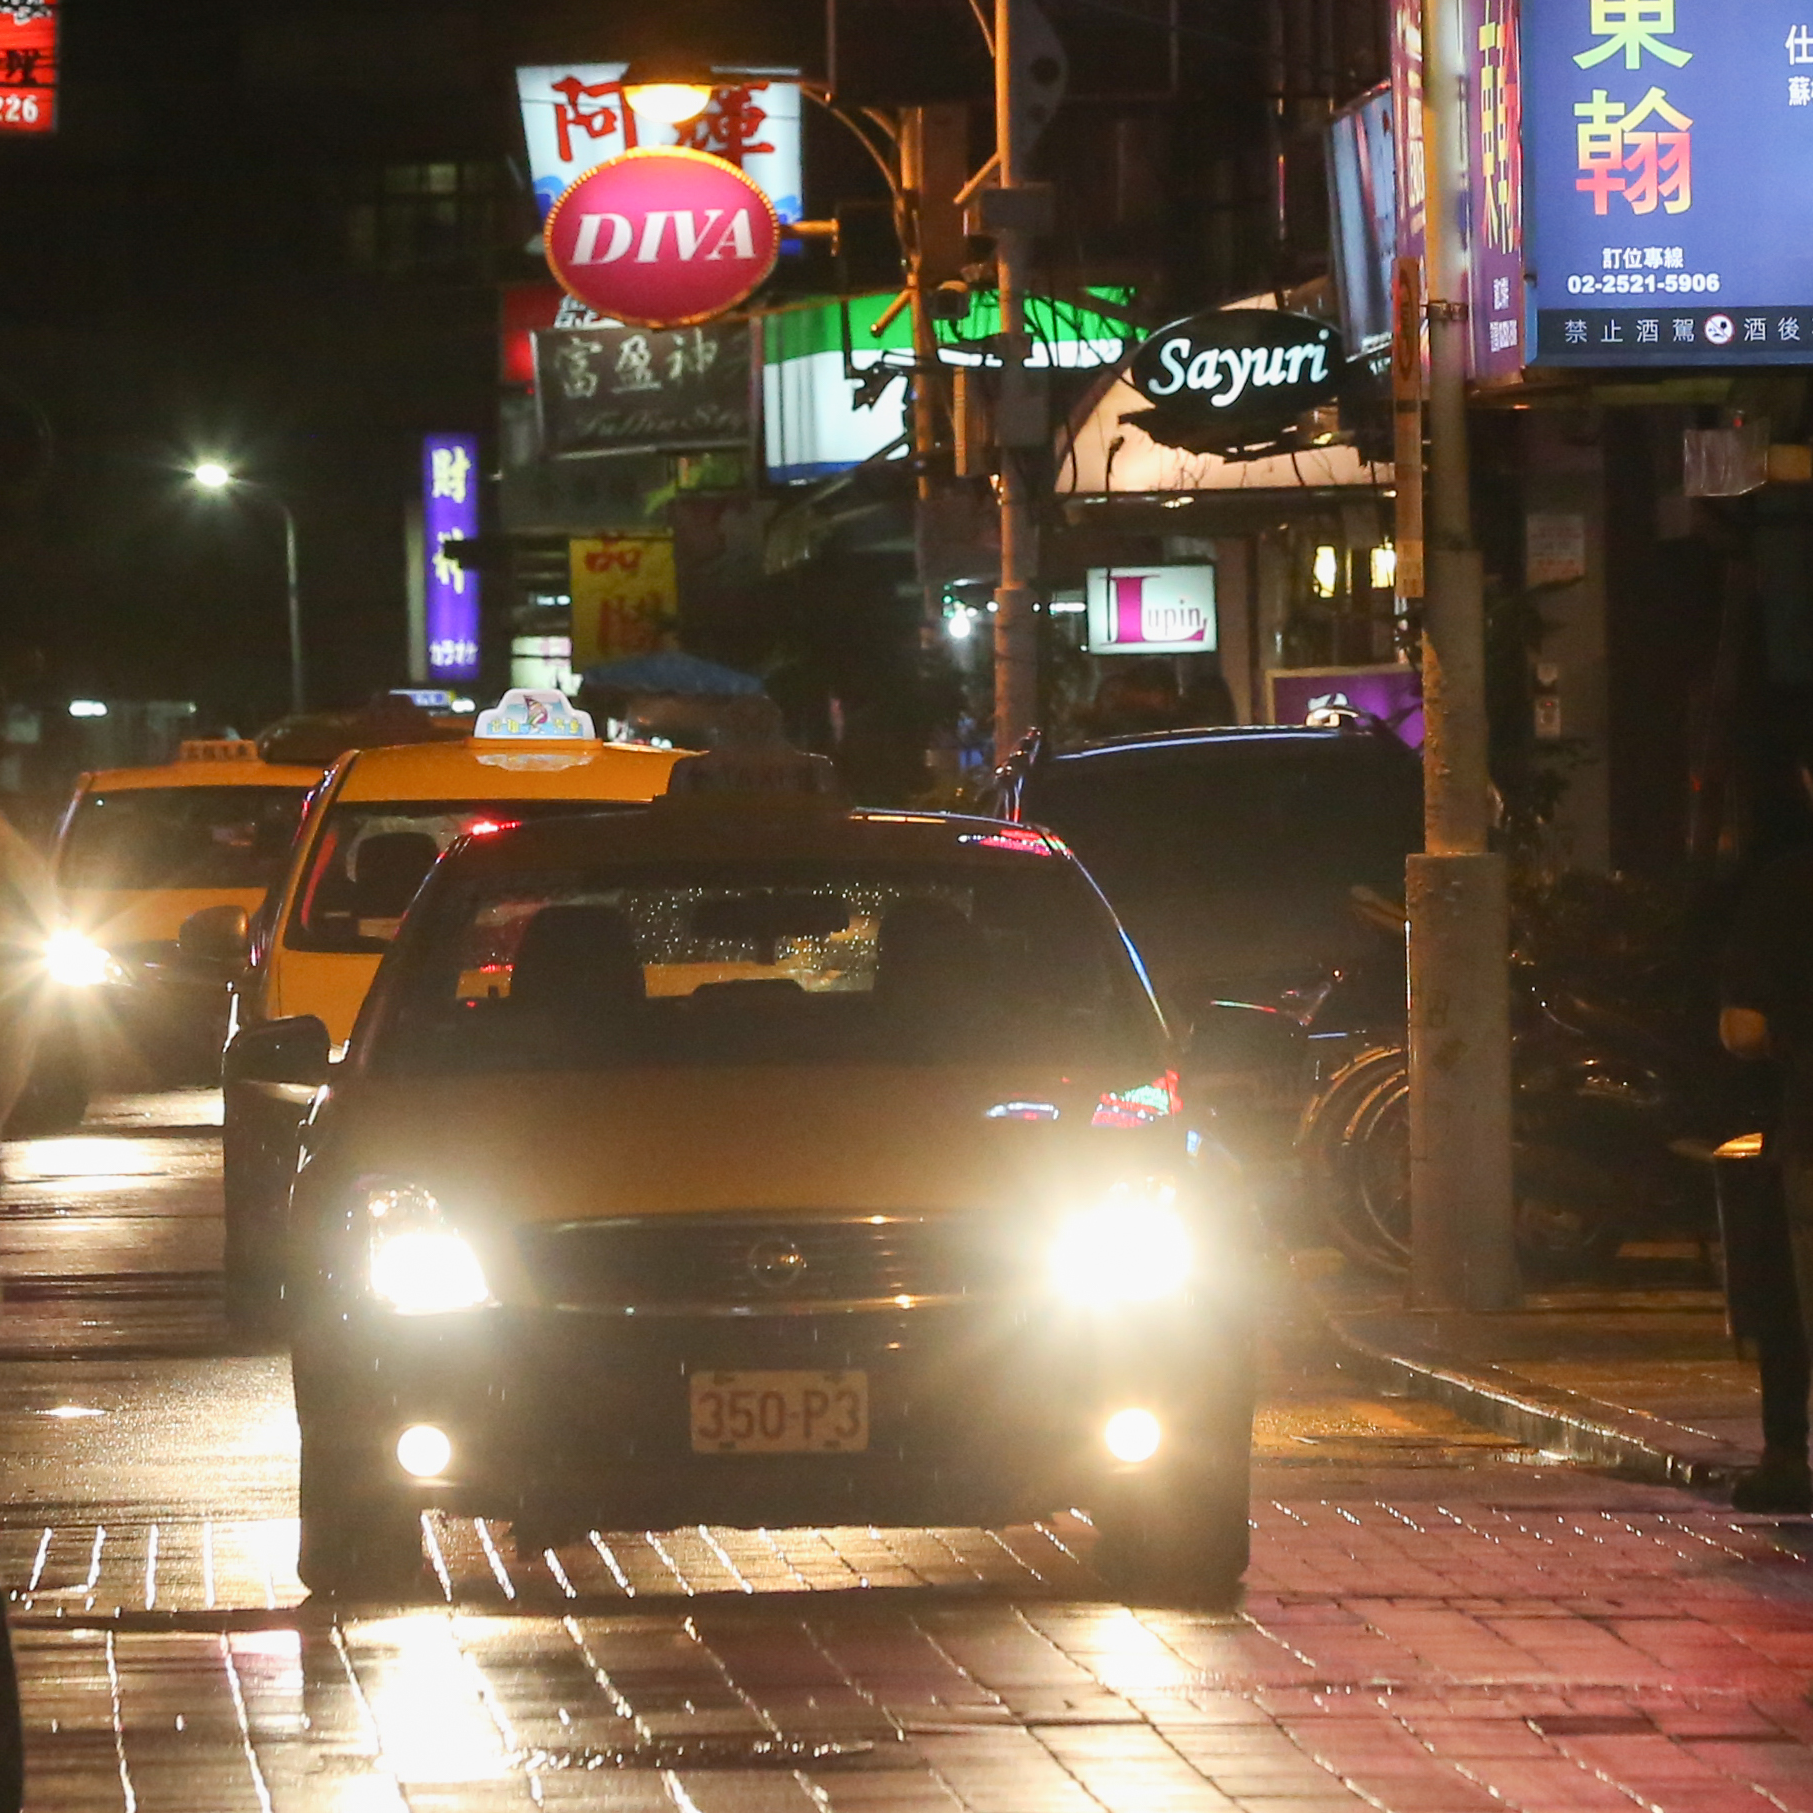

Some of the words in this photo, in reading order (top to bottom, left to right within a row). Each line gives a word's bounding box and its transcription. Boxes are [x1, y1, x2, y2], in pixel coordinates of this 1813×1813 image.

[568, 207, 757, 266] DIVA
[1602, 246, 1684, 270] 訂位專線
[1567, 273, 1721, 295] 02-2521-5906
[1565, 318, 1695, 344] 禁止酒駕
[1147, 328, 1330, 408] Sayuri
[1098, 574, 1208, 646] Lupin
[696, 1389, 861, 1441] 350-P3
